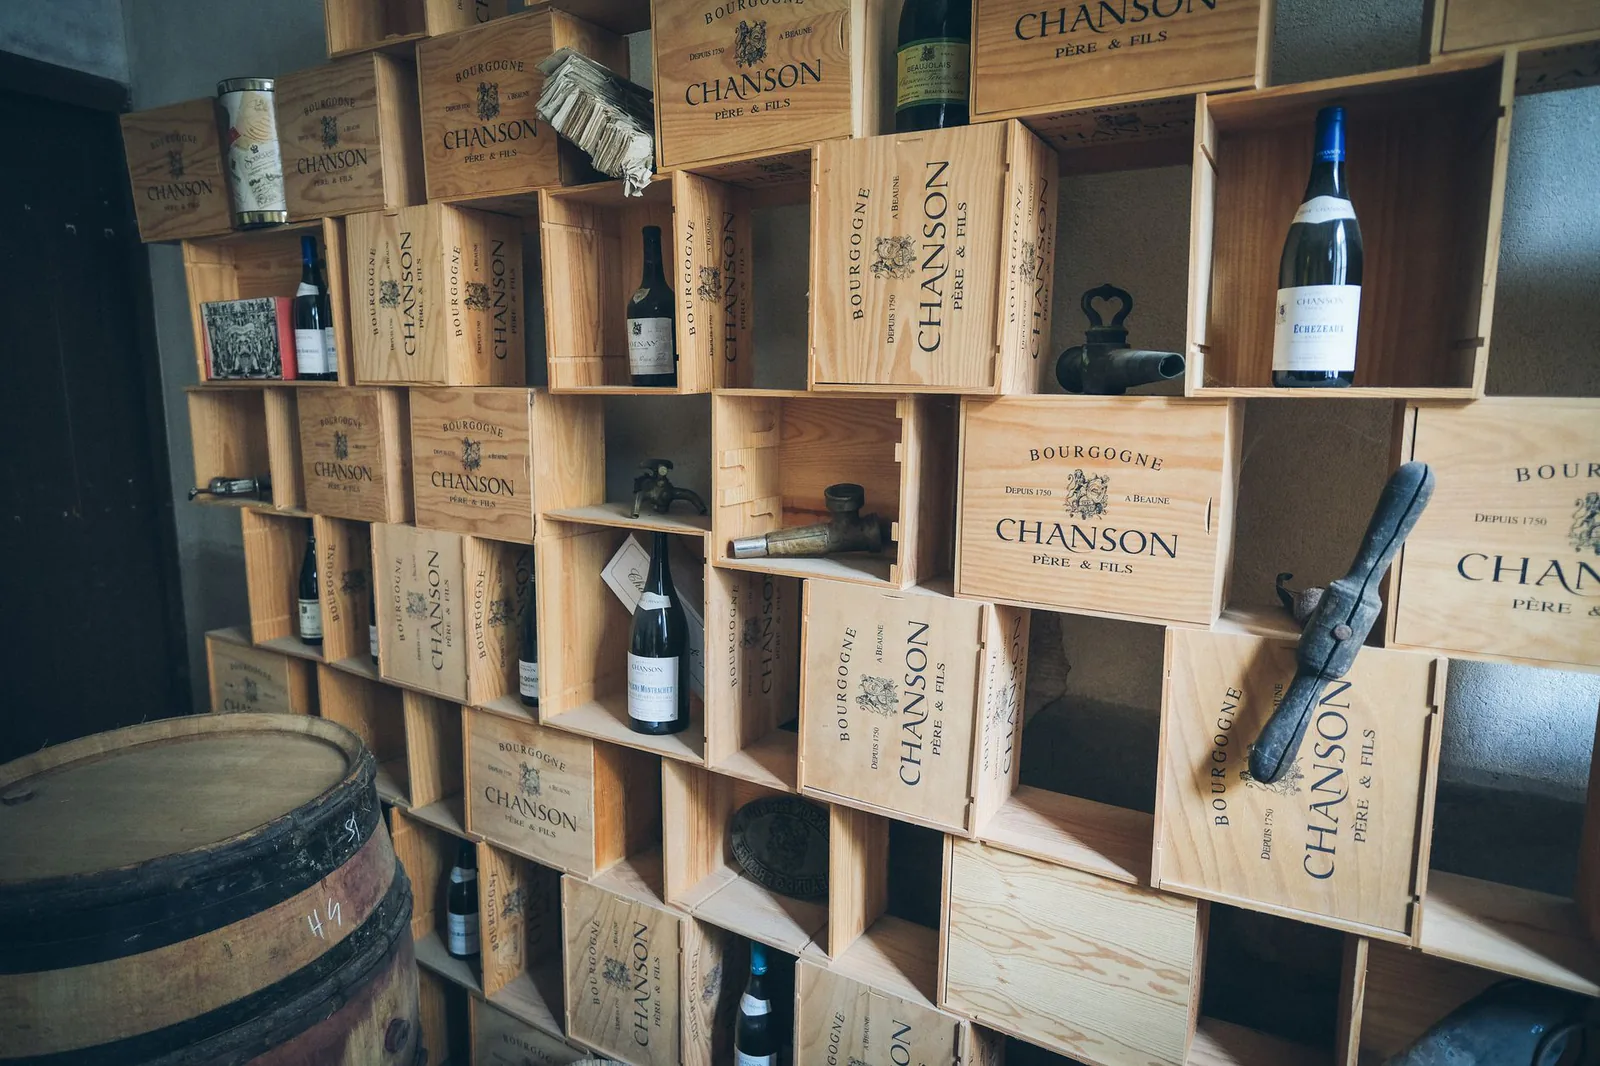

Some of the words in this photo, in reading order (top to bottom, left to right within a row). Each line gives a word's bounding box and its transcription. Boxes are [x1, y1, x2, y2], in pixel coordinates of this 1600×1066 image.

[785, 26, 813, 39] BEAUNE
[1055, 43, 1098, 59] PÈRE
[1108, 38, 1121, 50] &
[1130, 30, 1168, 46] FILS
[455, 59, 525, 83] BOURGOGNE
[689, 51, 712, 61] DEPUIS
[907, 61, 952, 73] BEAUJOLAIS
[685, 59, 822, 106] CHANSON
[303, 96, 356, 116] BOURGOGNE
[714, 107, 744, 121] PÈRE
[750, 104, 760, 114] &
[765, 98, 791, 112] FILS
[443, 119, 538, 150] CHANSON
[297, 148, 368, 175] CHANSON
[464, 152, 485, 164] PÈRE
[499, 149, 517, 159] FILS
[147, 178, 213, 201] CHANSON
[891, 175, 900, 212] BEAUNE
[892, 212, 898, 220] A
[956, 201, 967, 238] FILS
[849, 187, 871, 321] BOURGOGNE
[917, 160, 950, 353] CHANSON
[956, 245, 965, 258] &
[1032, 176, 1049, 359] CHANSON
[367, 247, 379, 336] BOURGOGNE
[400, 231, 416, 356] CHANSON
[449, 245, 462, 337] BOURGOGNE
[684, 219, 696, 336] BOURGOGNE
[723, 211, 738, 363] CHANSON
[951, 268, 964, 311] PÈRE
[492, 239, 508, 360] CHANSON
[887, 312, 895, 344] DEPUIS
[319, 415, 363, 430] BOURGOGNE
[442, 420, 504, 438] BOURGOGNE
[314, 461, 373, 482] CHANSON
[1030, 445, 1163, 471] BOURGOGNE
[431, 470, 514, 496] CHANSON
[1005, 485, 1034, 496] DEPUIS
[1035, 488, 1052, 497] 1750
[449, 494, 467, 505] PÈRE
[480, 500, 496, 508] FILS
[1133, 494, 1170, 505] BEAUNE
[1474, 513, 1518, 525] DEPUIS
[1522, 516, 1548, 526] 1750
[996, 517, 1178, 559] CHANSON
[1032, 553, 1071, 568] PÈRE
[1080, 560, 1092, 569] &
[1100, 562, 1133, 574] FILS
[326, 543, 340, 623] BOURGOGNE
[393, 556, 406, 642] BOURGOGNE
[427, 550, 444, 671] CHANSON
[474, 569, 487, 660] BOURGOGNE
[1512, 597, 1572, 614] PÈRE
[1588, 605, 1600, 617] &
[728, 584, 740, 688] BOURGOGNE
[876, 624, 884, 656] BEAUNE
[631, 663, 663, 673] CHANSON
[836, 626, 857, 742] BOURGOGNE
[936, 662, 946, 694] FILS
[899, 620, 930, 786] CHANSON
[935, 700, 944, 711] &
[1003, 616, 1022, 775] CHANSON
[930, 719, 942, 756] PÈRE
[1360, 728, 1376, 767] FILS
[498, 742, 567, 773] BOURGOGNE
[870, 744, 879, 770] DEPUIS
[1211, 686, 1243, 826] BOURGOGNE
[1303, 678, 1353, 880] CHANSON
[1359, 775, 1373, 789] &
[484, 785, 577, 832] CHANSON
[1263, 808, 1274, 826] 1750
[1350, 799, 1369, 844] PÈRE
[504, 814, 525, 827] PÈRE
[538, 827, 557, 838] FILS
[1260, 826, 1272, 861] DEPUIS
[587, 919, 600, 1006] BOURGOGNE
[653, 956, 661, 981] FILS
[633, 920, 651, 1048] CHANSON
[862, 1016, 870, 1045] BEAUNE
